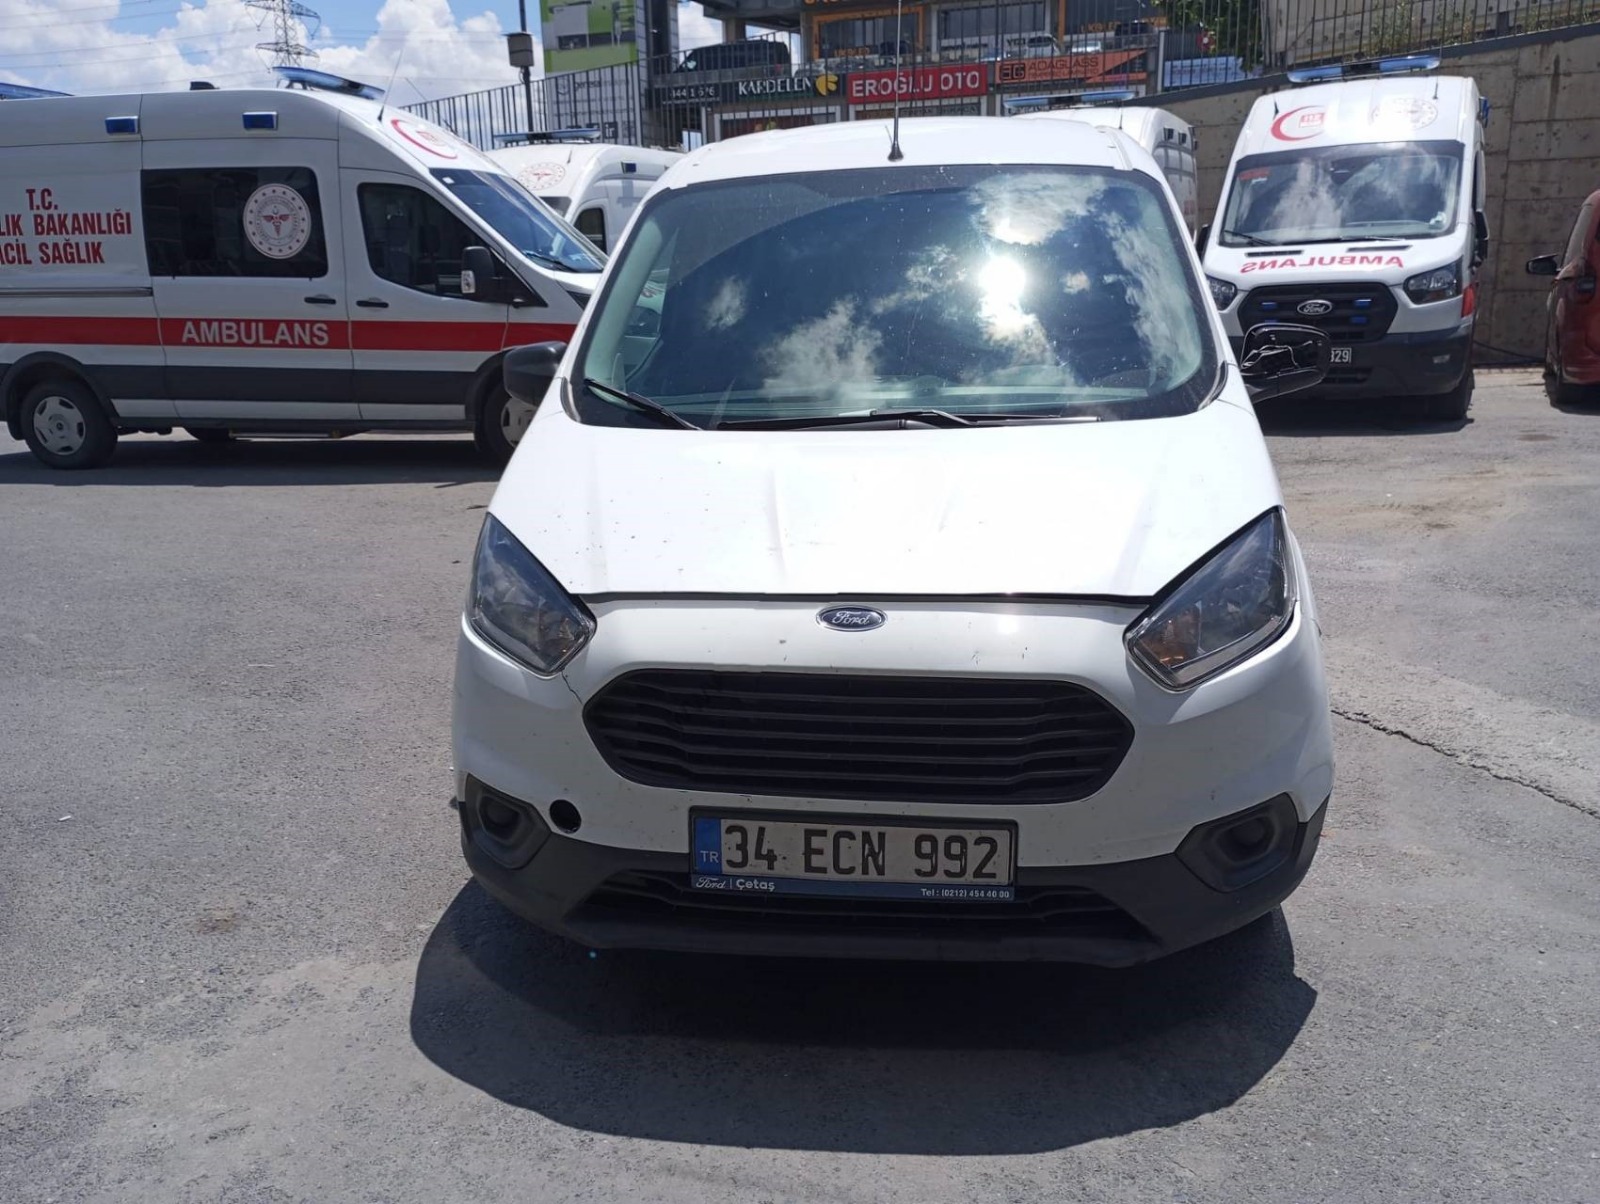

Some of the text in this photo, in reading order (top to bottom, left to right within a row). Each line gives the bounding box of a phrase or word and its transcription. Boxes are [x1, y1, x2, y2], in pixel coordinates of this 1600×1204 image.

[1028, 56, 1098, 72] ADAGLASS
[738, 77, 812, 96] KARDELEN
[852, 70, 980, 97] EROĞLU OTO
[26, 188, 58, 210] T.C.
[34, 208, 132, 236] BAKANLIĞI
[38, 238, 105, 265] SAĞLIK
[1303, 303, 1326, 313] Ford
[182, 321, 329, 346] AMBULANS
[831, 610, 870, 625] Ford
[701, 850, 719, 863] TR
[724, 824, 998, 879] 34 ECN 992
[696, 876, 775, 892] Ford Çetaş
[941, 888, 967, 899] (0212)
[969, 889, 985, 898] 454
